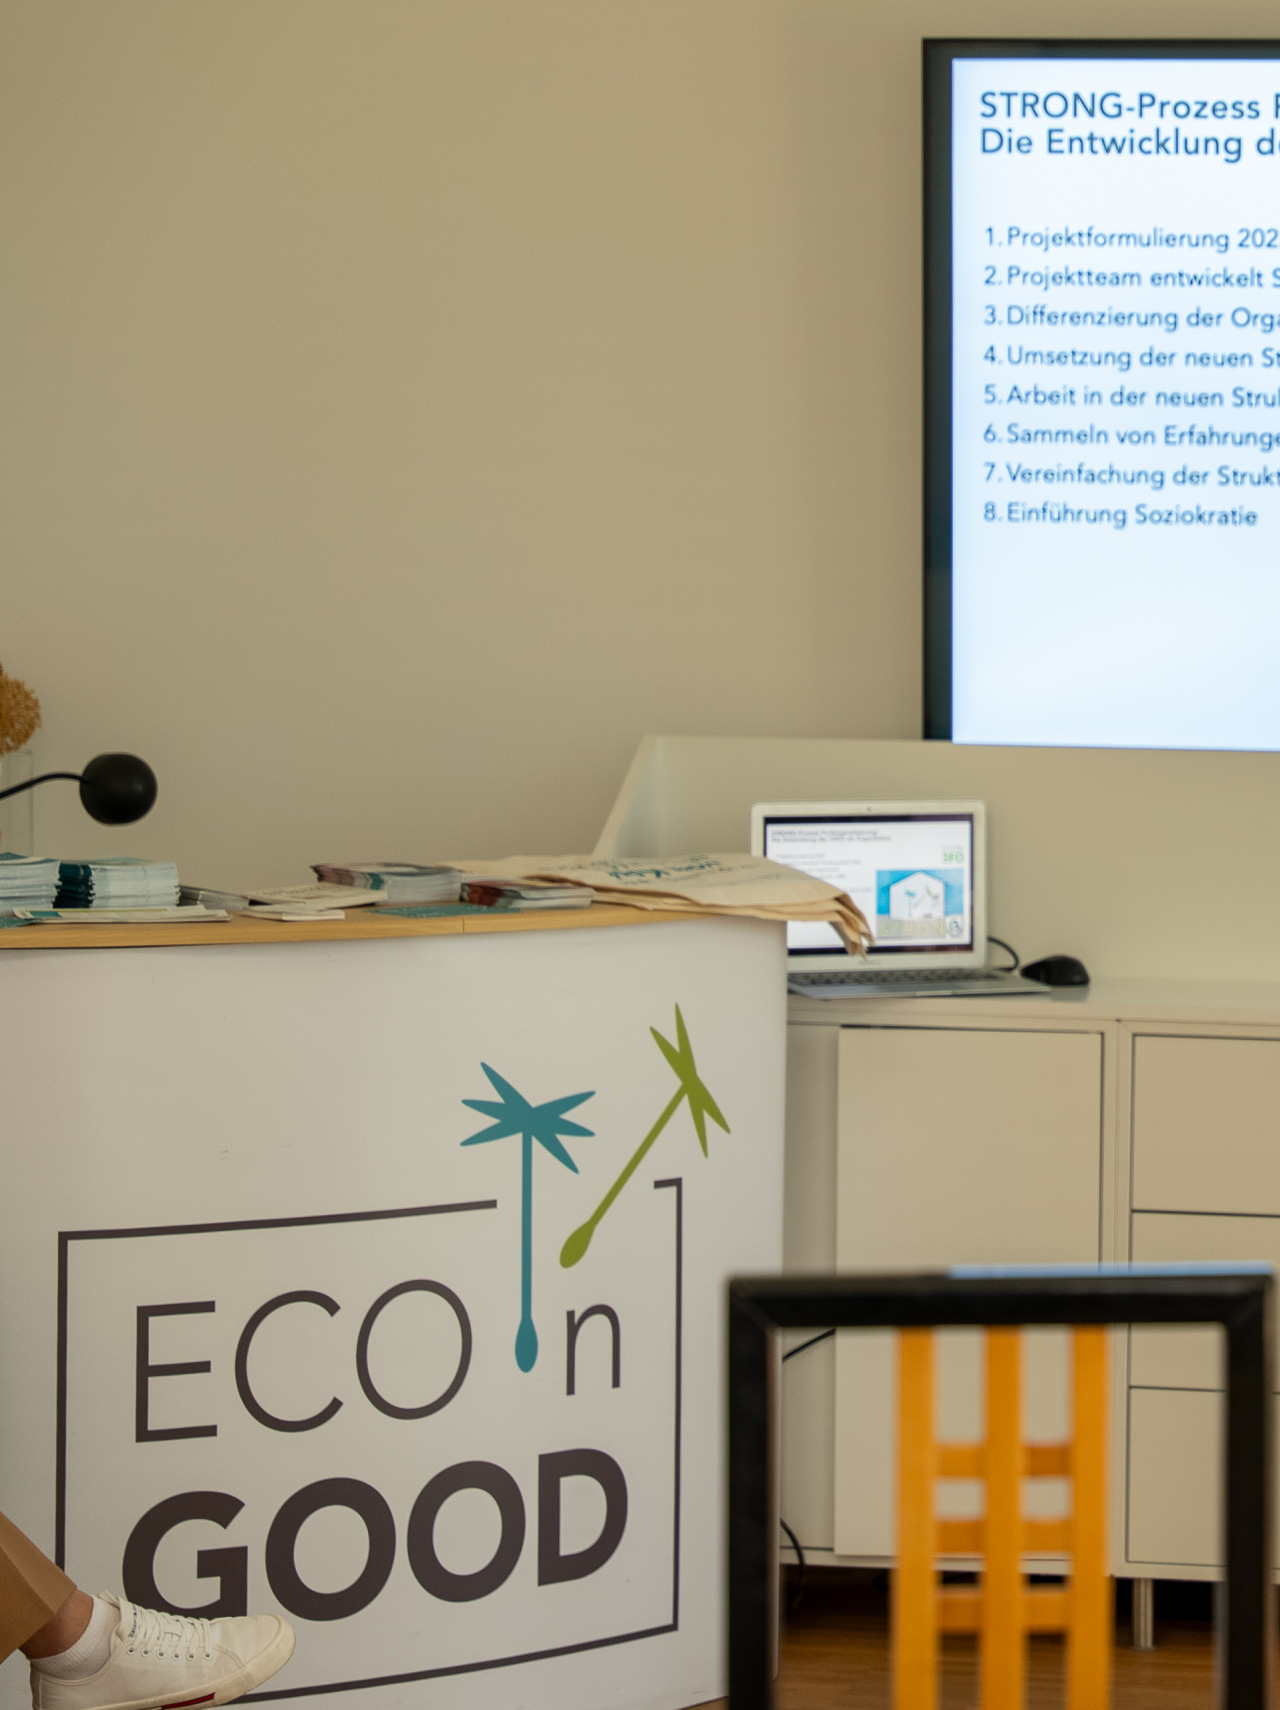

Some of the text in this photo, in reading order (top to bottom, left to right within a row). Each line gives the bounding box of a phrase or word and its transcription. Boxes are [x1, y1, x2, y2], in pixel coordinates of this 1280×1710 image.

[980, 90, 1261, 120] STRONG-Prozess
[980, 127, 1034, 155] Die
[1046, 126, 1243, 165] Entwicklung
[1007, 225, 1230, 254] Projektformulierung
[1007, 265, 1142, 291] Projektteam
[1150, 266, 1264, 288] entwickelt
[1007, 304, 1179, 333] Differenzierung
[1186, 306, 1224, 328] der
[1007, 345, 1132, 372] Umsetzung
[1139, 345, 1177, 368] der
[1185, 352, 1253, 368] neuen
[1006, 384, 1076, 406] Arbeit
[1084, 385, 1103, 405] in
[1110, 384, 1148, 407] der
[1155, 391, 1224, 408] neuen
[1007, 422, 1109, 445] Sammeln
[1116, 430, 1156, 446] von
[1006, 462, 1165, 491] Vereinfachung
[1172, 464, 1210, 486] der
[1007, 501, 1128, 530] Einführung
[1135, 503, 1258, 527] Soziokratie
[122, 1447, 629, 1622] GOOD
